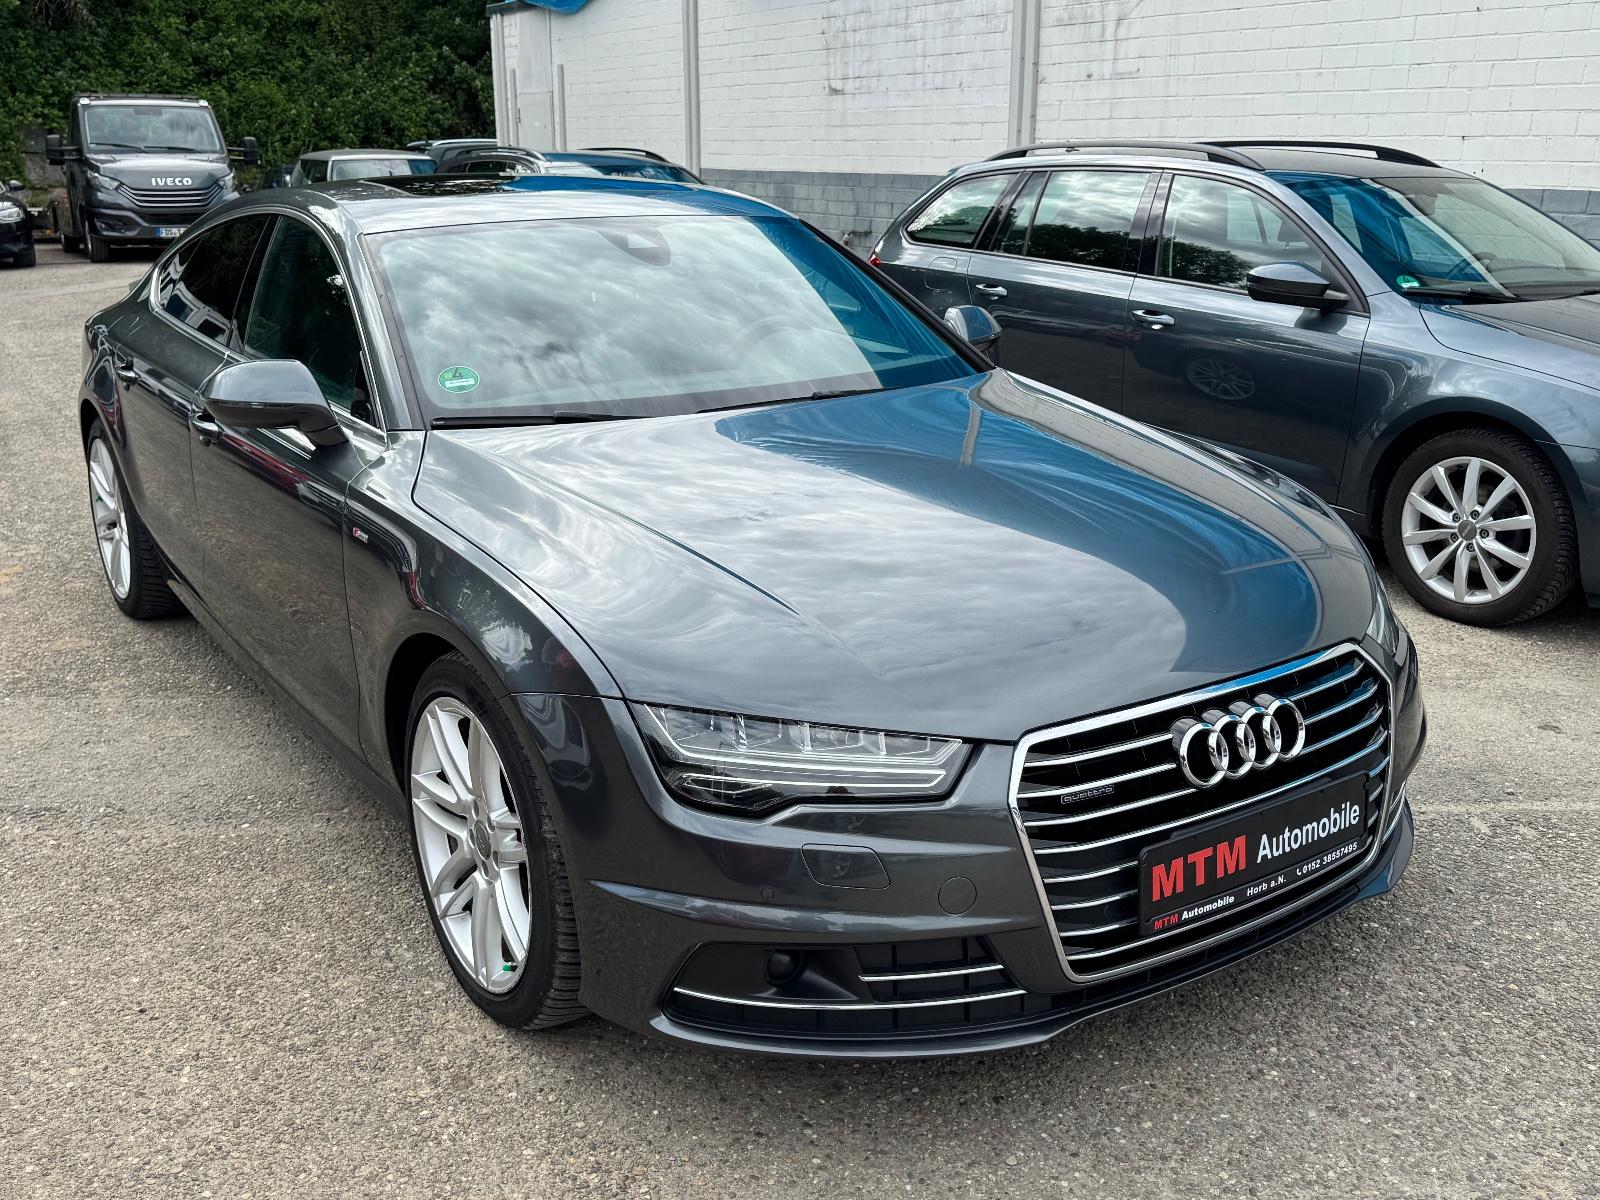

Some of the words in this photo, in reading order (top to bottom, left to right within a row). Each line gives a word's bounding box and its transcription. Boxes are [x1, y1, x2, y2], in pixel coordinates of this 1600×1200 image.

[152, 177, 192, 186] IVECO
[1063, 786, 1114, 802] quattro
[1152, 834, 1246, 902] MTM
[1256, 801, 1360, 864] Automobile
[1154, 913, 1179, 930] MTM
[1181, 895, 1235, 921] Automobile
[1246, 883, 1268, 897] Horb
[1270, 874, 1288, 888] a.N.
[1302, 859, 1321, 874] 0152
[1322, 841, 1358, 865] 38557495
